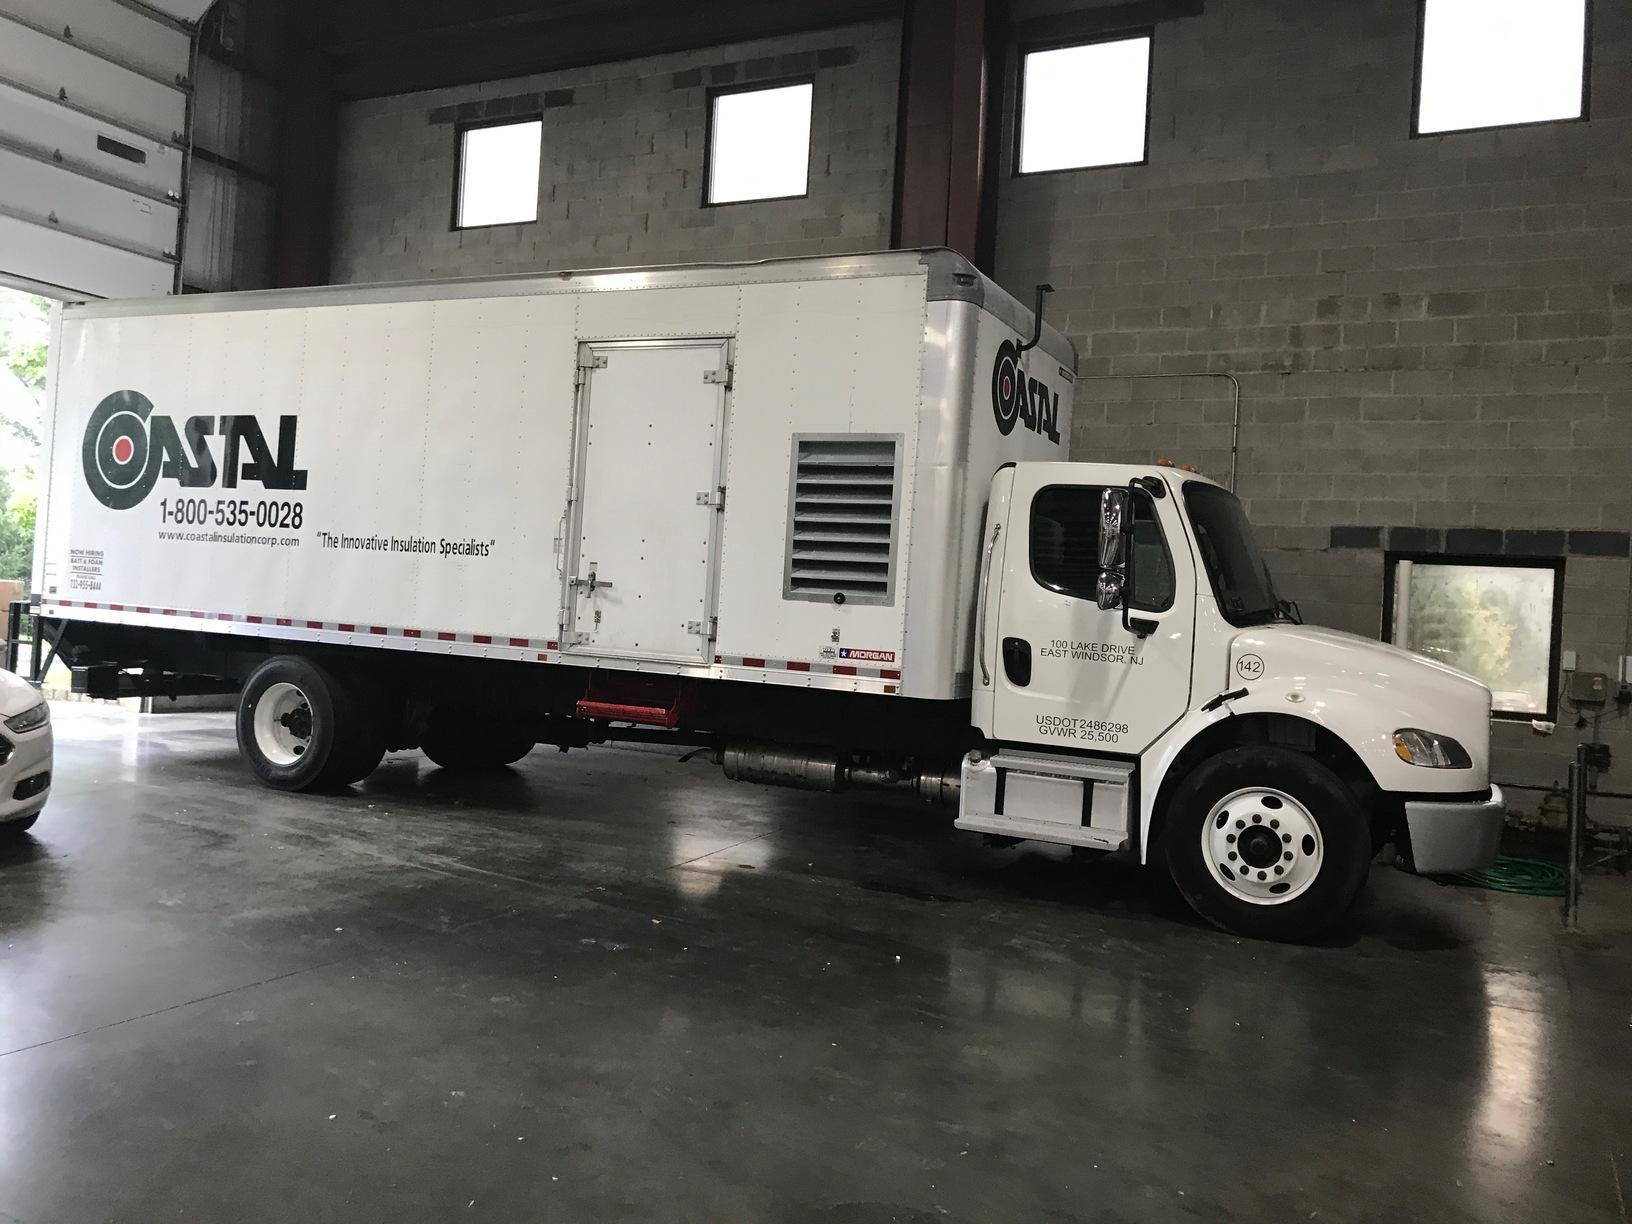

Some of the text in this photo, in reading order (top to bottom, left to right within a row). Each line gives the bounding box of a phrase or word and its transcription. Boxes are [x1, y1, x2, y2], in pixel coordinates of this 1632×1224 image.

[992, 339, 1060, 445] COASTAL
[82, 389, 308, 510] COASTAL
[160, 498, 303, 529] 1-800-535-0028
[158, 531, 300, 548] www.coastalinsulationcorp.com
[317, 531, 496, 558] "The Innovative Insulation Specialists"
[849, 650, 894, 661] MORGAN
[1050, 640, 1135, 655] 100 LAKE DRIVE
[1040, 648, 1144, 665] EAST WINDSOR, NJ
[1238, 660, 1261, 673] 142
[1038, 725, 1119, 743] GVWR 25,500
